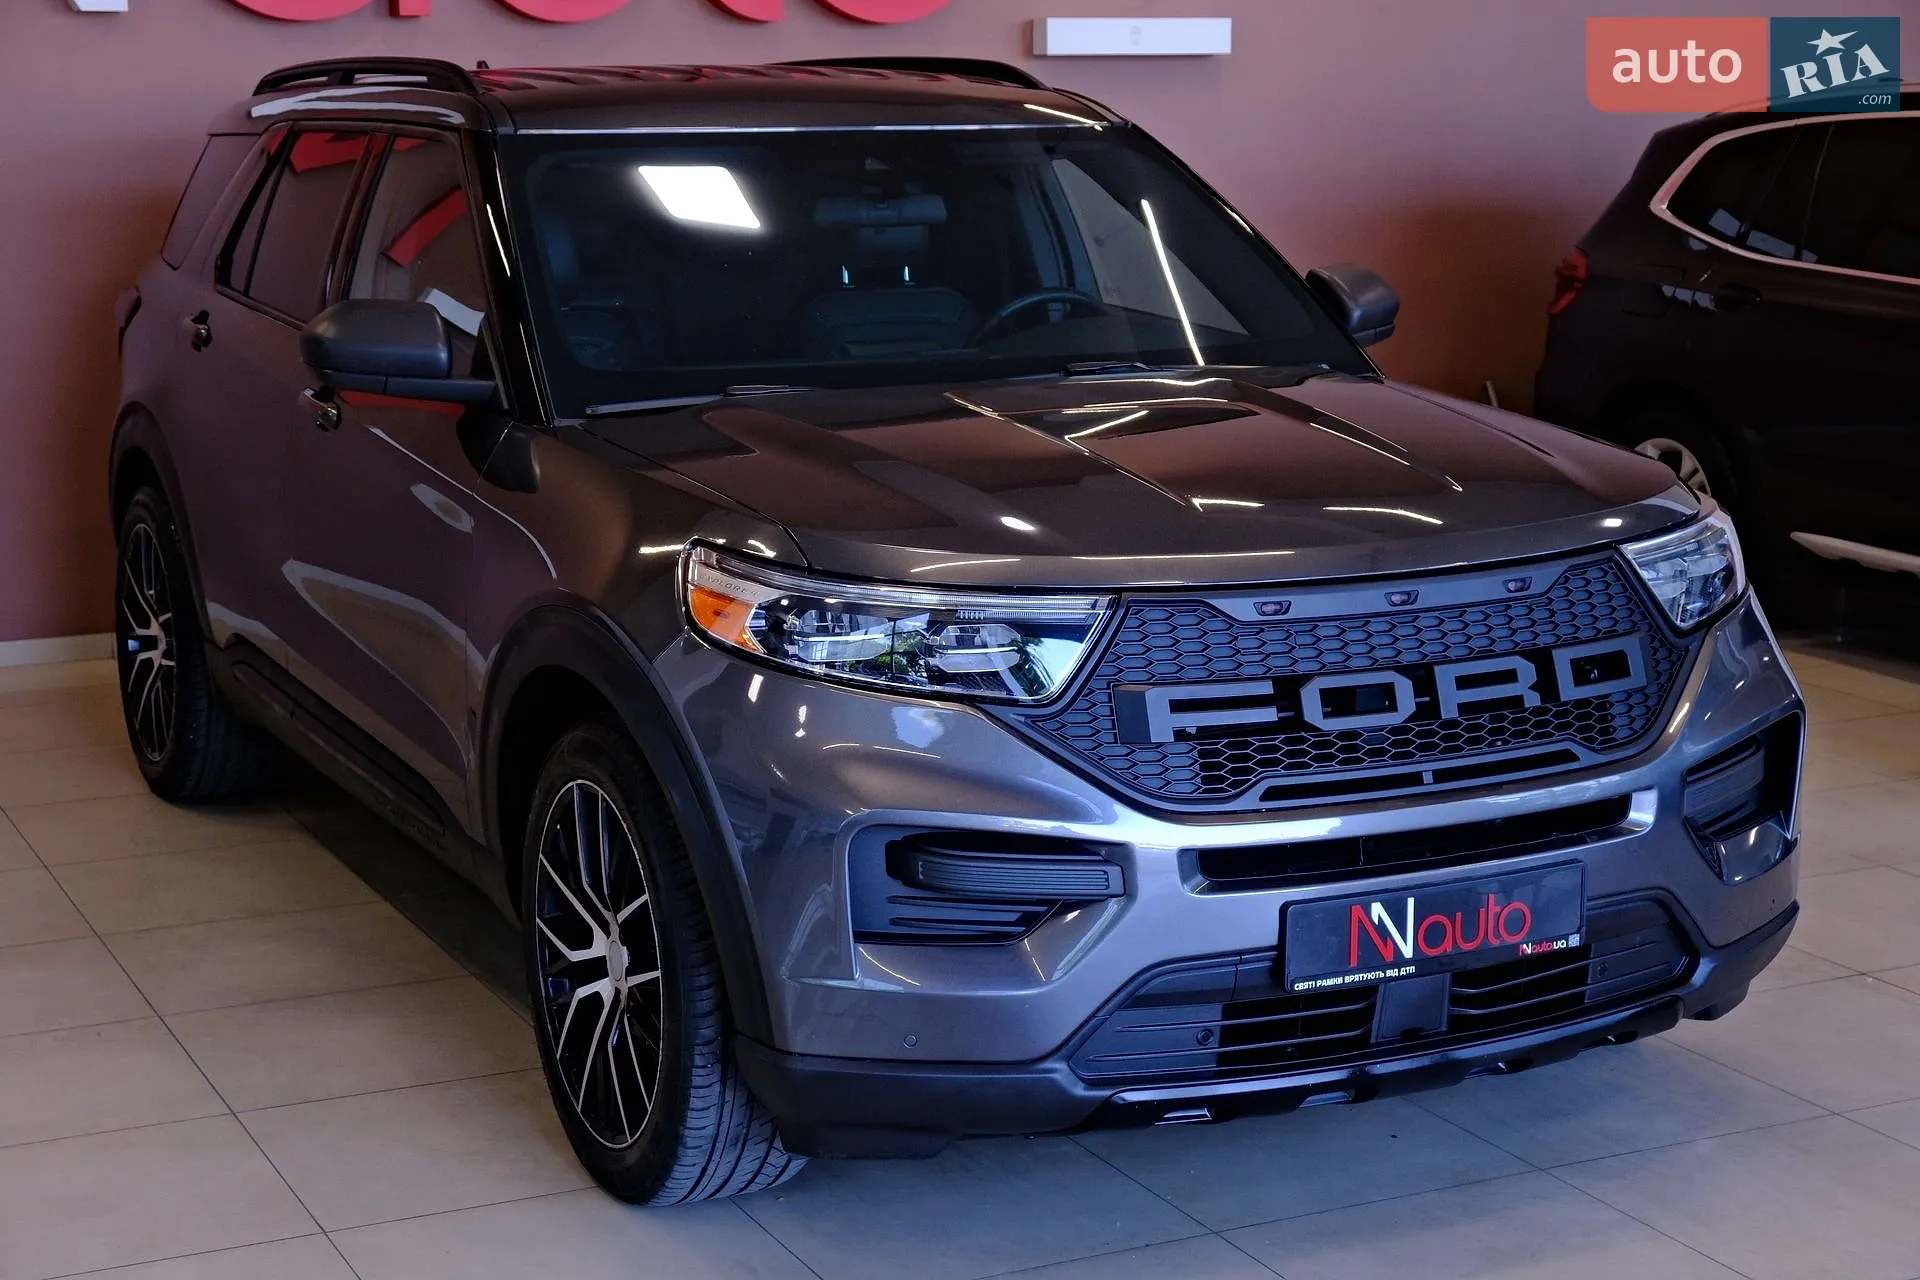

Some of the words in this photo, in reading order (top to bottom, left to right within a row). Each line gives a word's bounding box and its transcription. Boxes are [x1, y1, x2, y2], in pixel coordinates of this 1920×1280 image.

[1143, 636, 1646, 743] FORD
[1294, 981, 1315, 990] СВЯТІ
[1316, 977, 1343, 988] РАМКИ
[1344, 971, 1384, 984] ВРЯТУЮТЬ
[1386, 968, 1399, 977] ВІД
[1400, 965, 1415, 976] ДТП
